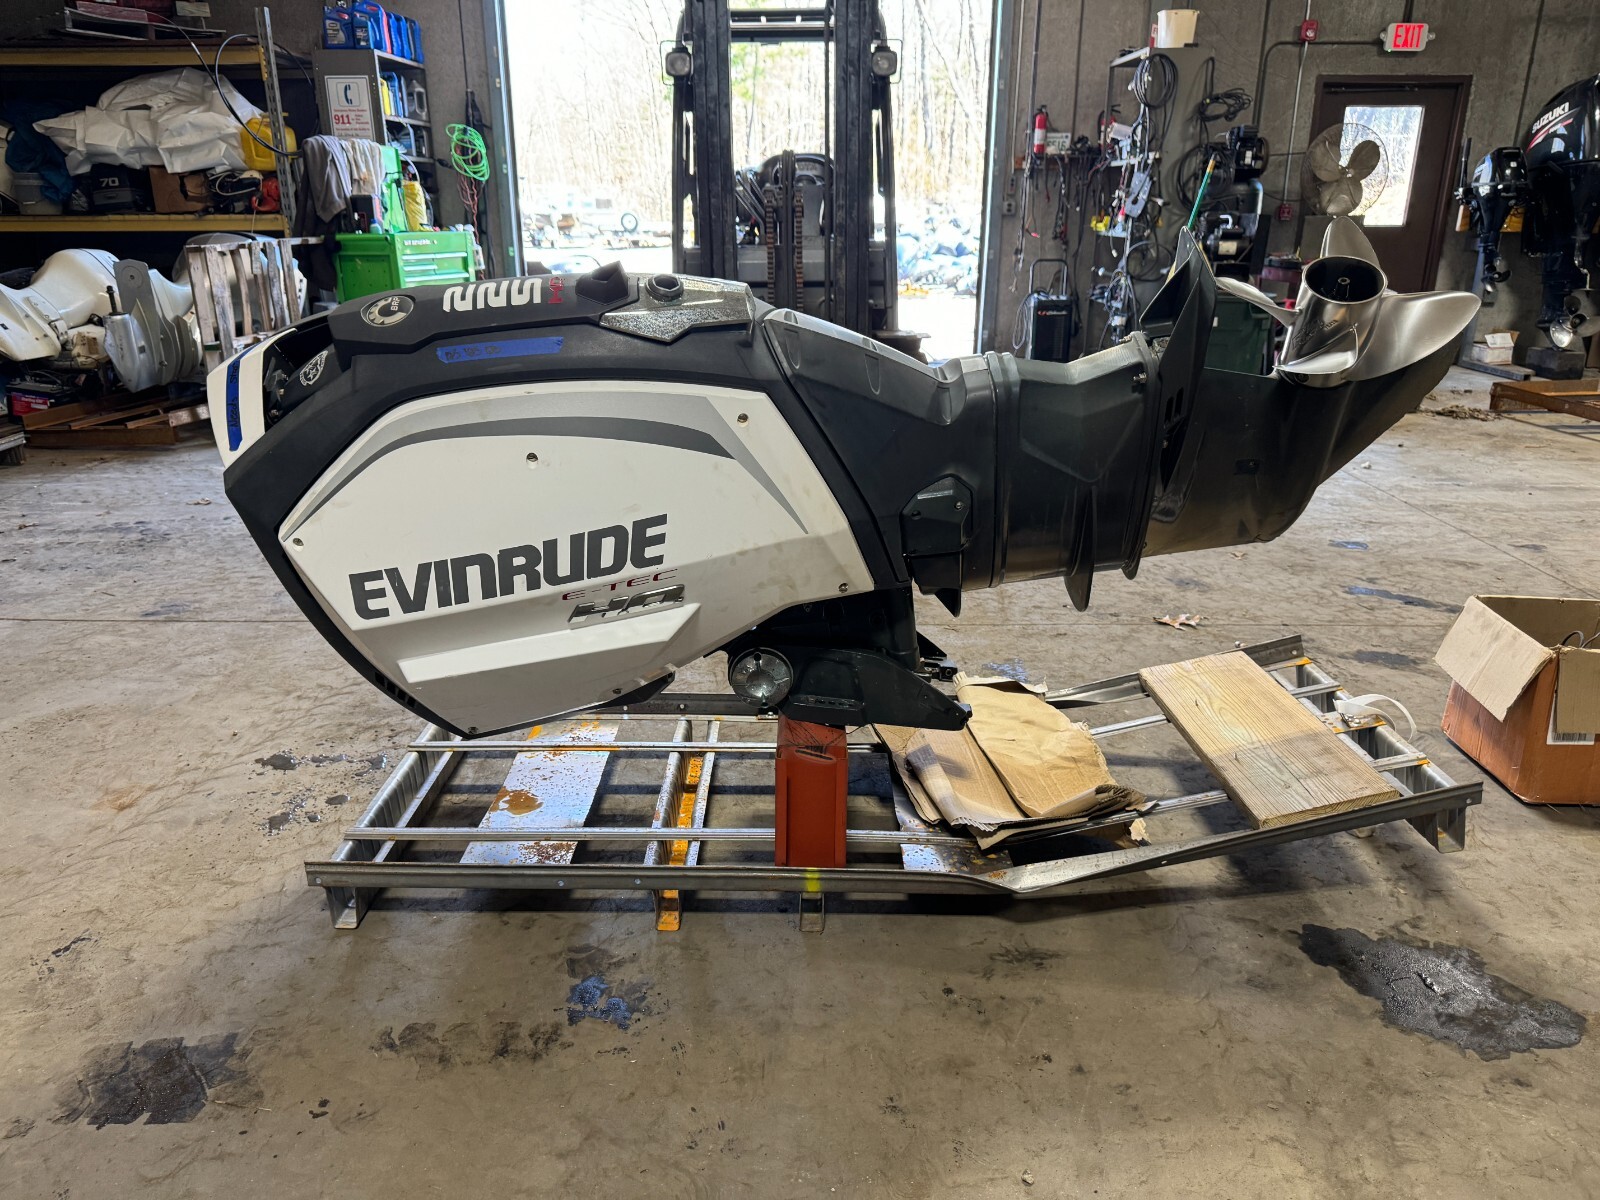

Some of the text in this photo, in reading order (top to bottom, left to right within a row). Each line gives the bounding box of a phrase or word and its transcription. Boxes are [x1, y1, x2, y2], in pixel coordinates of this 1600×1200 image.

[1393, 24, 1425, 48] EXIT
[334, 114, 352, 125] 911
[1531, 101, 1570, 134] SUZUKI
[100, 177, 119, 187] 70
[390, 296, 400, 311] BRP
[227, 396, 239, 428] Needs
[348, 513, 668, 621] EVINRUDE
[562, 568, 678, 601] E-TEC
